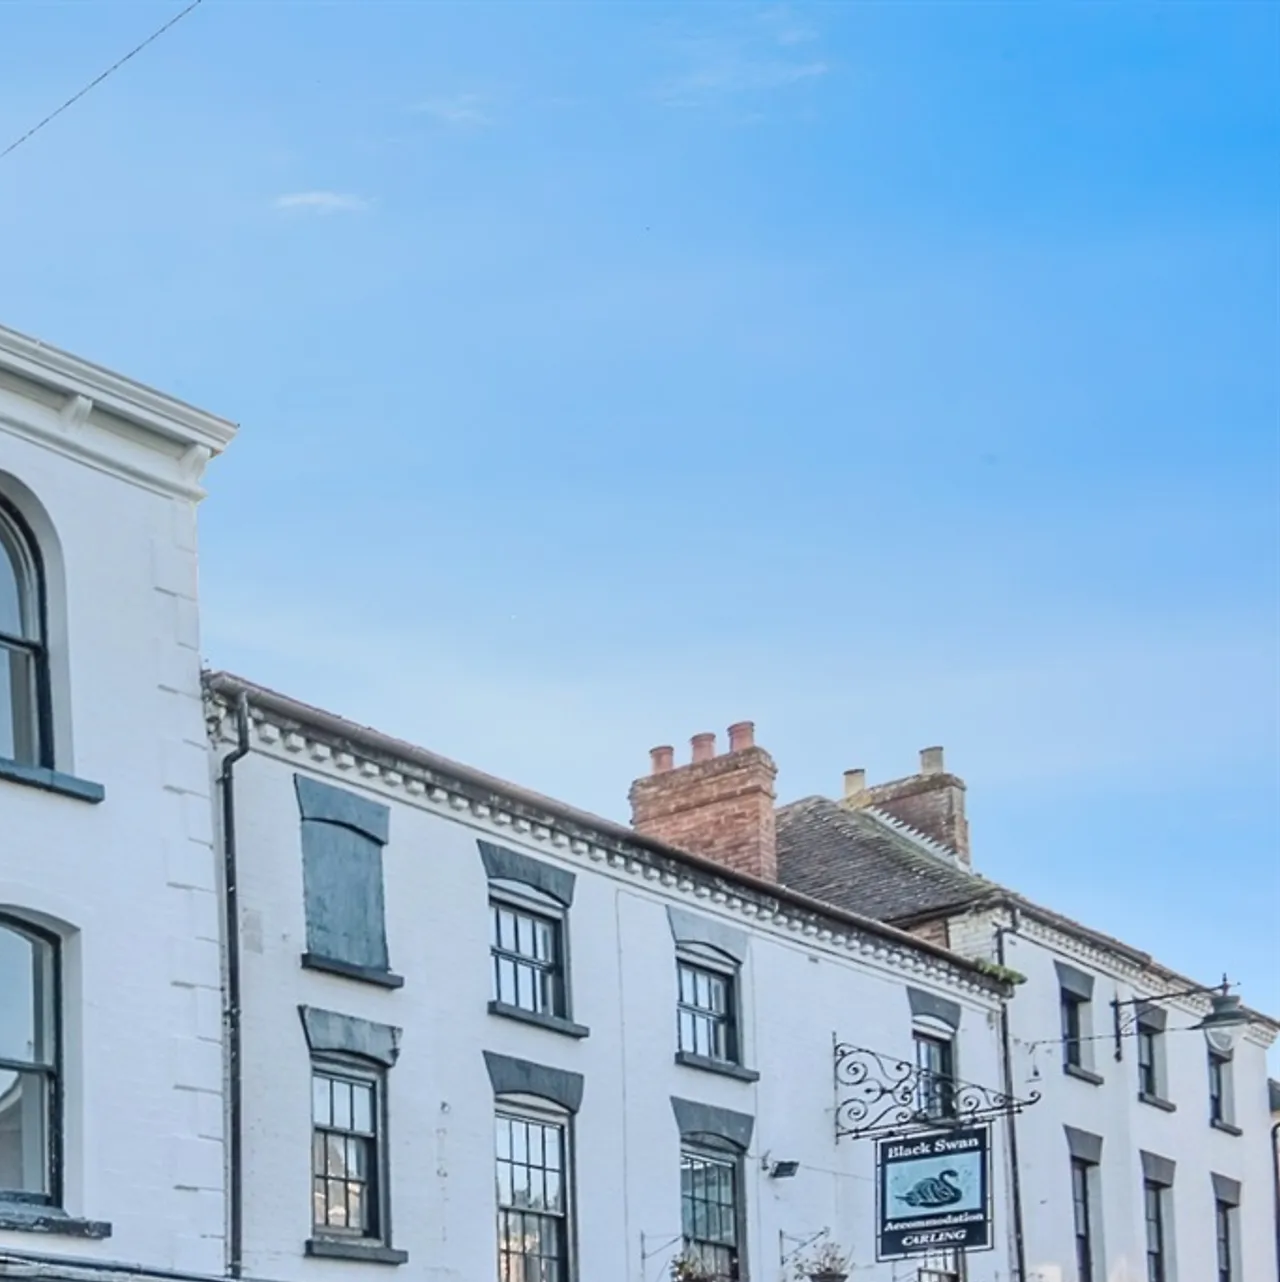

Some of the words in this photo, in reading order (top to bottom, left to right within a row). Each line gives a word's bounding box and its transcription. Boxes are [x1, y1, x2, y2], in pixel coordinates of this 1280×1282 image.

[888, 1142, 931, 1158] Black
[934, 1138, 978, 1152] Swan
[884, 1212, 984, 1232] Accommodation
[901, 1229, 967, 1246] CARLING
